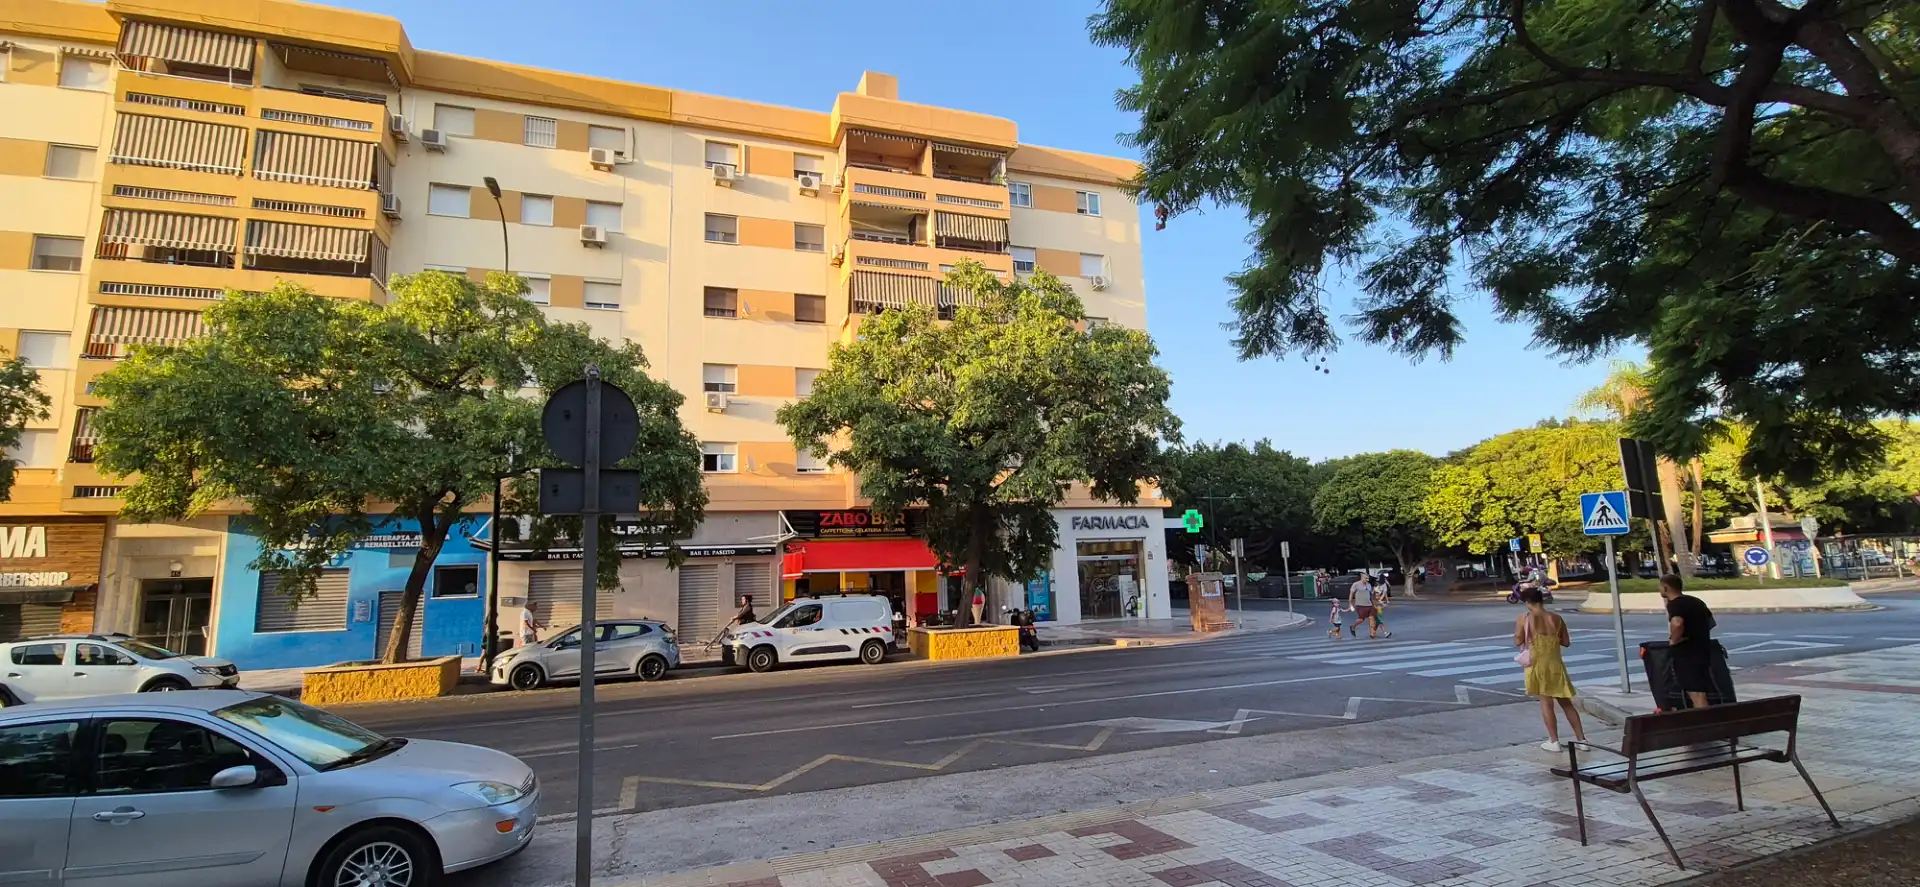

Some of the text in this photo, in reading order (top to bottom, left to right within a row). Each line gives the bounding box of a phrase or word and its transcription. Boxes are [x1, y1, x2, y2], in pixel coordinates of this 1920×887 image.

[820, 511, 868, 526] ZABO
[1072, 515, 1150, 530] FARMACIA
[0, 571, 69, 587] BERSHOP
